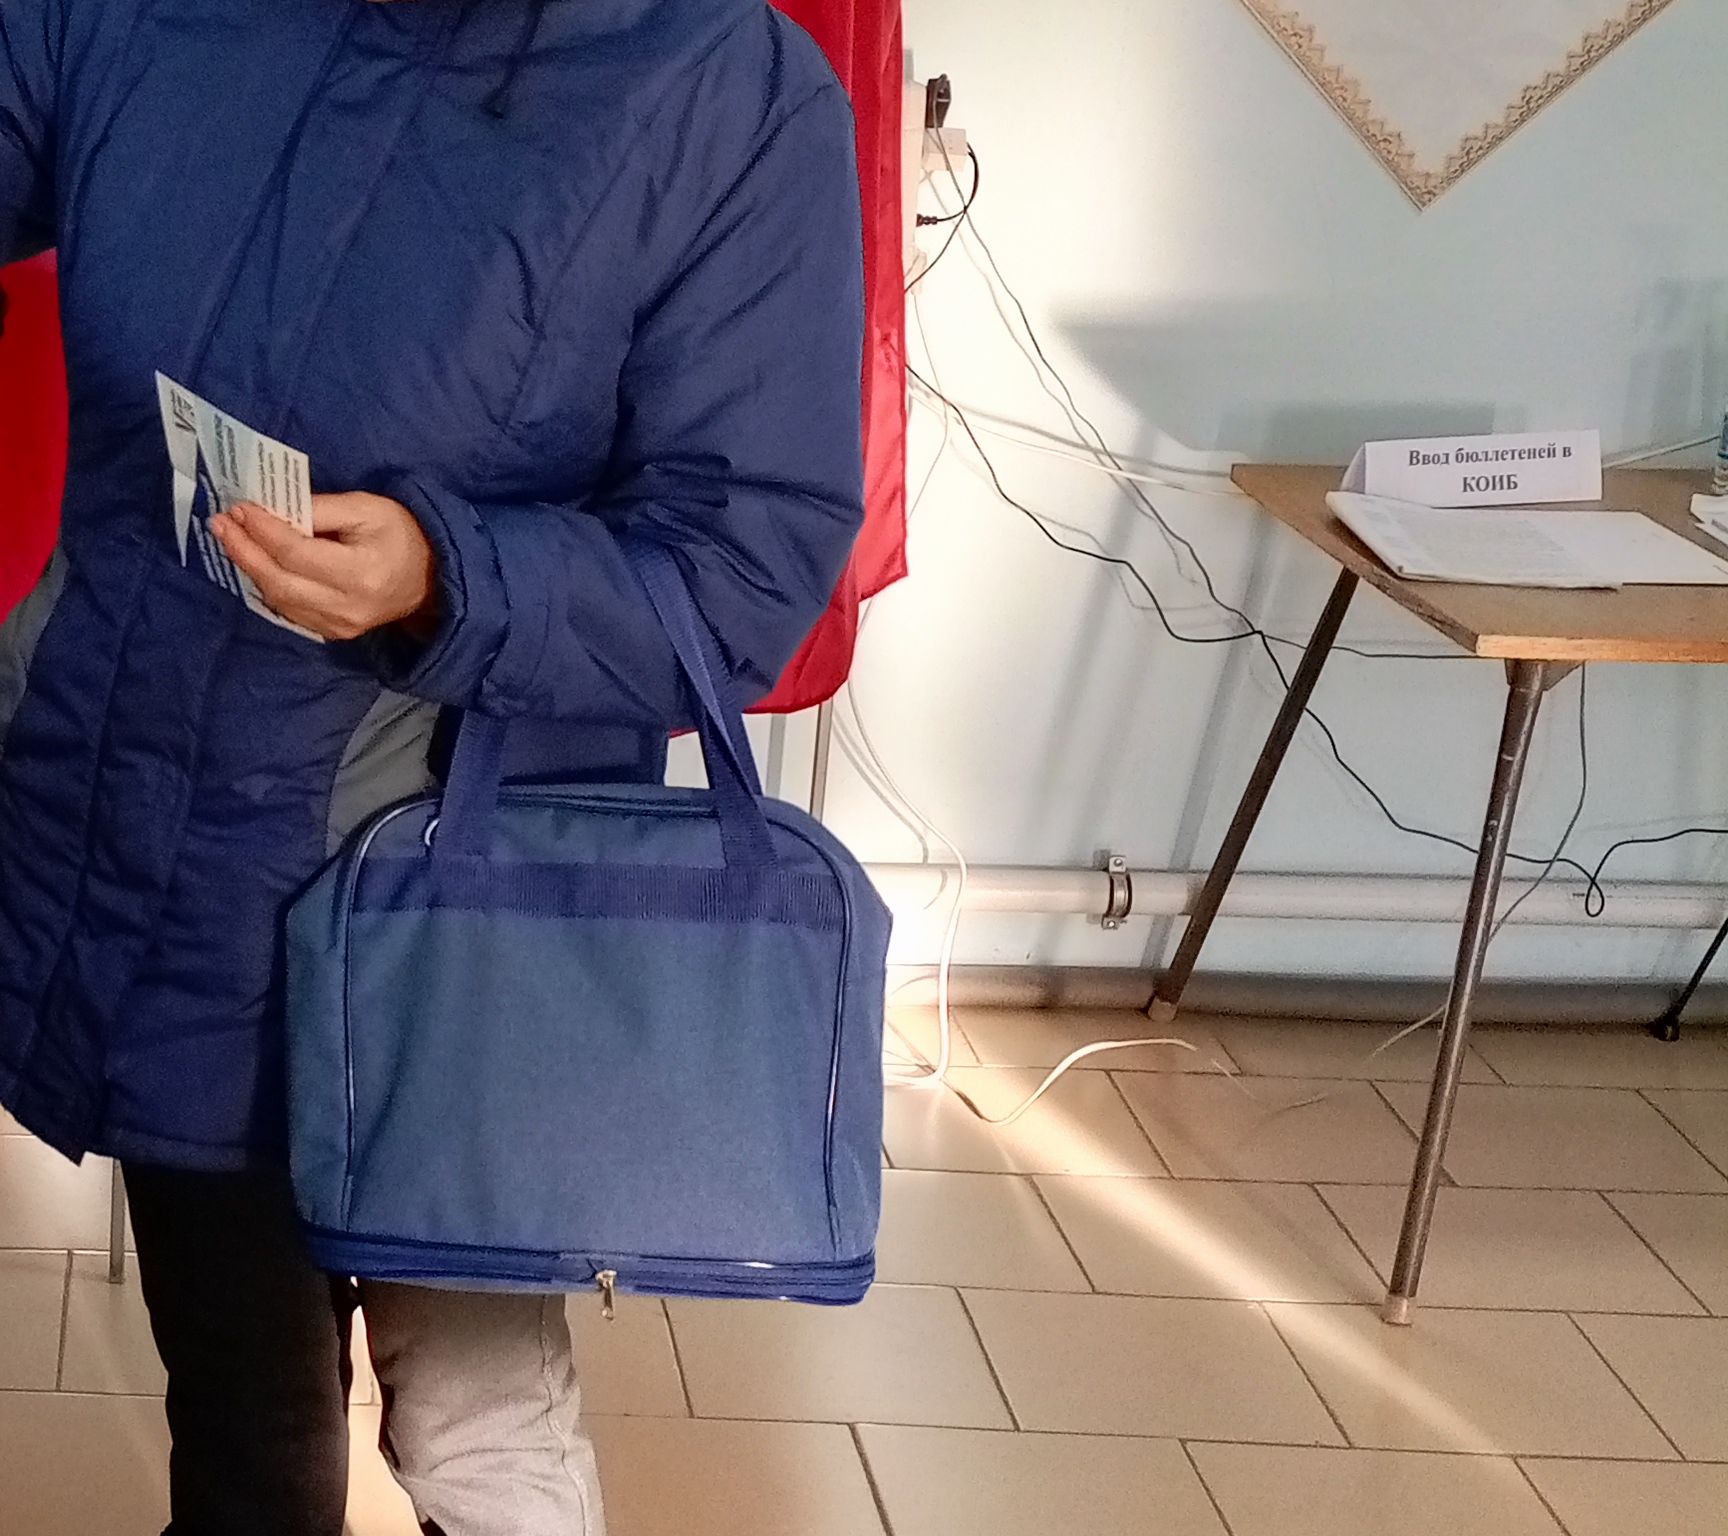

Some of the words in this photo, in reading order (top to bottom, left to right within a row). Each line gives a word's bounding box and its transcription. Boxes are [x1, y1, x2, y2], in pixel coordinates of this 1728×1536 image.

[1408, 449, 1450, 466] Ввод
[1455, 443, 1557, 464] бюллетеней
[1562, 446, 1573, 458] в
[1462, 474, 1519, 493] КОИБ
